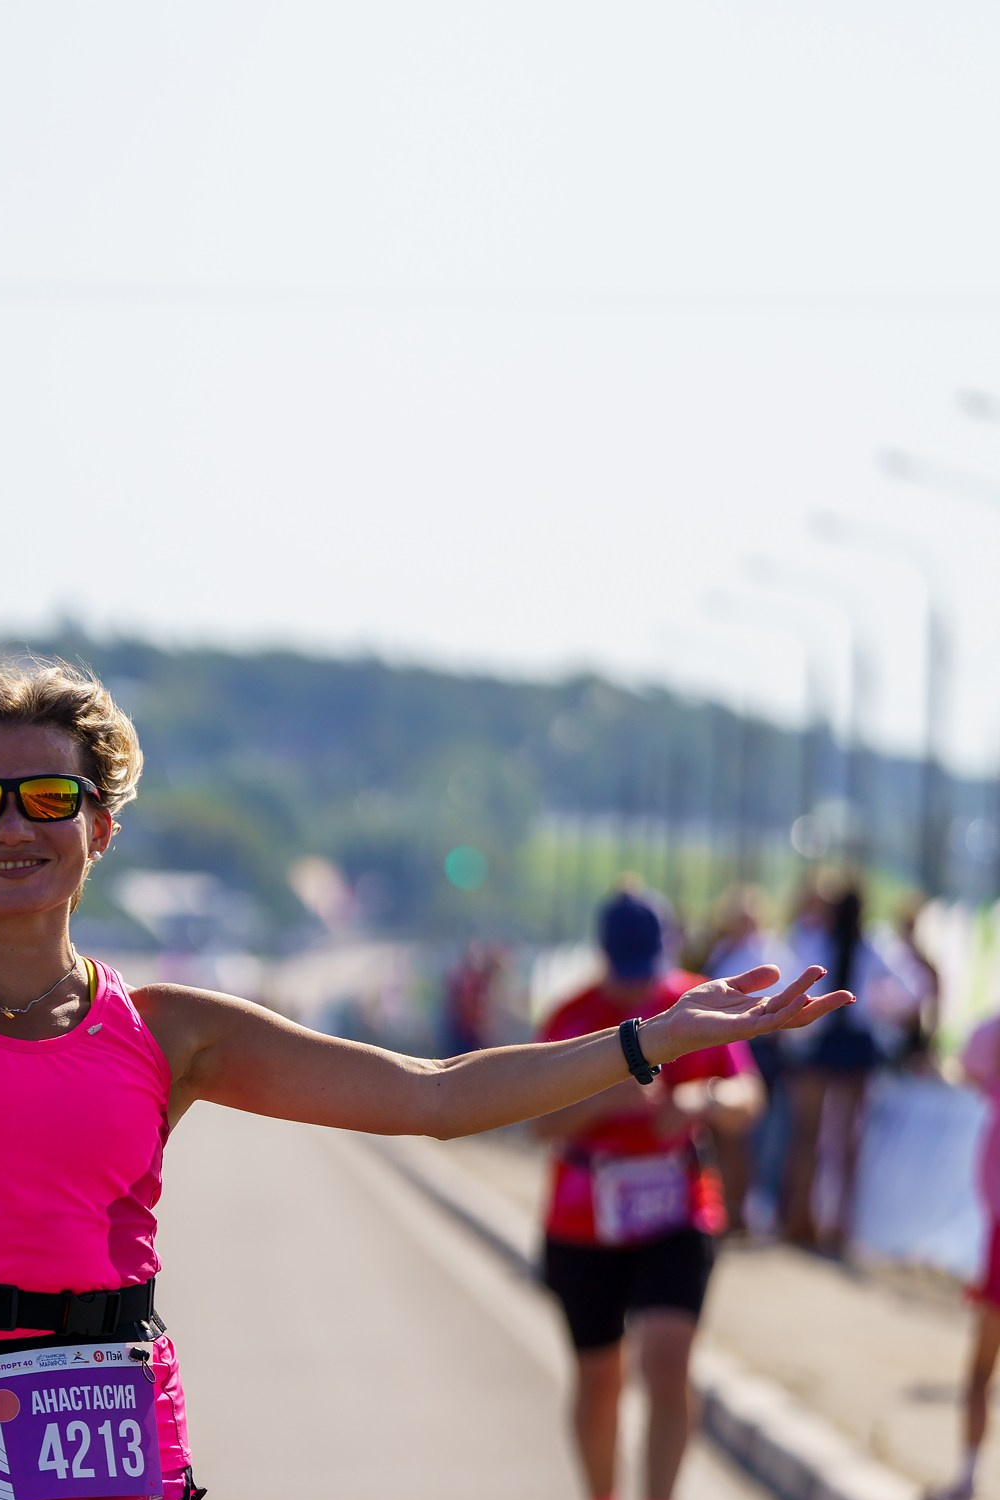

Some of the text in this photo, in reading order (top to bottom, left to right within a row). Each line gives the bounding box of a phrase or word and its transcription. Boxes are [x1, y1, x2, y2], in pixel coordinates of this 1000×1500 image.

[106, 1351, 122, 1360] Пэй
[32, 1385, 136, 1414] АНАСТАСИЯ
[38, 1419, 145, 1479] 4213
